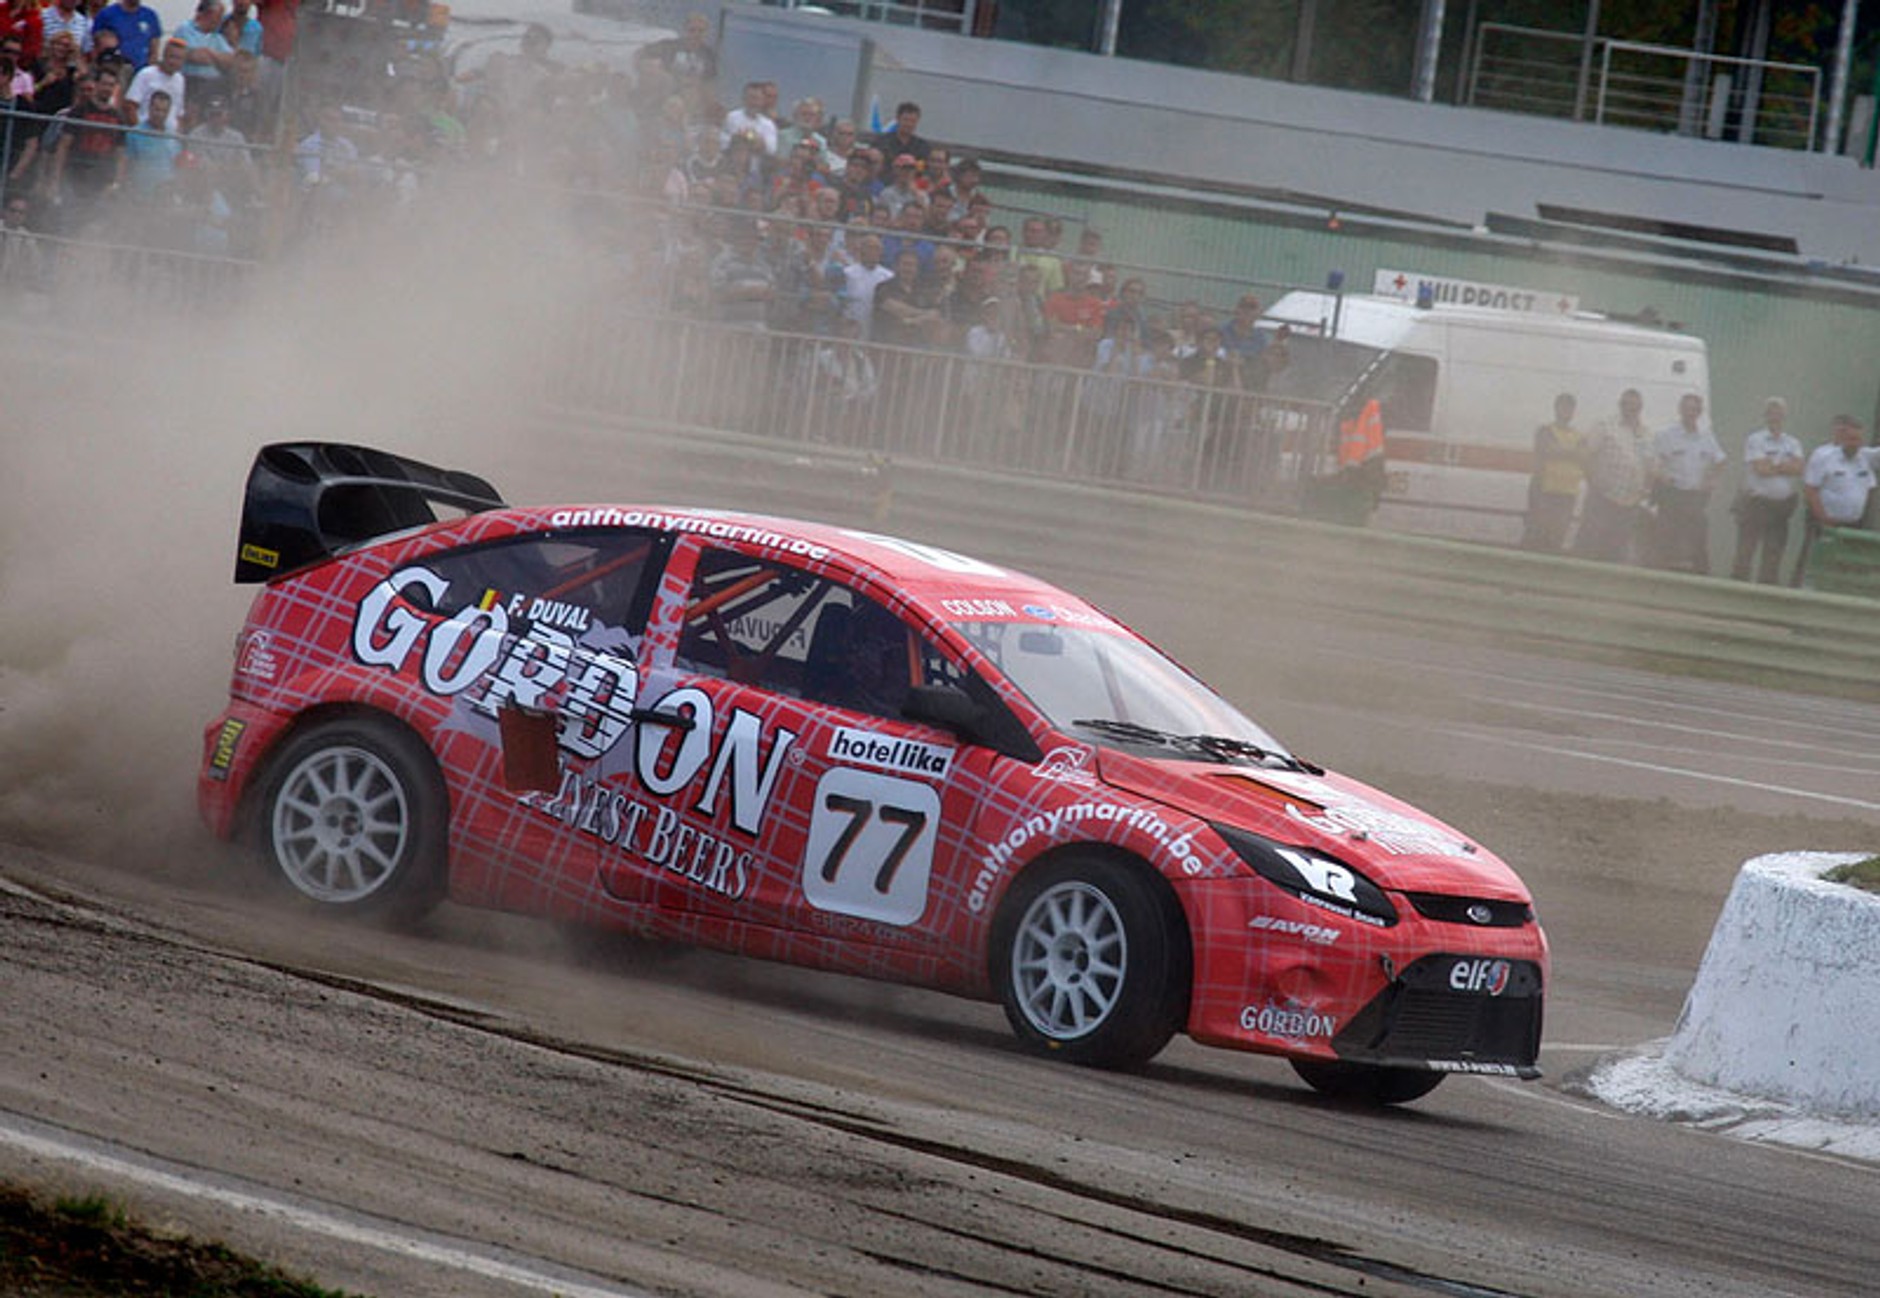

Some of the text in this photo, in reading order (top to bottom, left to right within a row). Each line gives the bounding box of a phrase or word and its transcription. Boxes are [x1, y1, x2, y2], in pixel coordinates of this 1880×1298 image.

[551, 508, 832, 560] anthonymartin.be
[507, 594, 590, 631] F. DUVAL
[353, 565, 797, 836] GORDON
[645, 803, 753, 900] BEERS
[821, 792, 927, 895] 77
[968, 801, 1204, 913] anthonymartin.be
[1264, 918, 1341, 940] AVON
[1449, 959, 1491, 991] elf
[1240, 1005, 1337, 1037] GORDON
